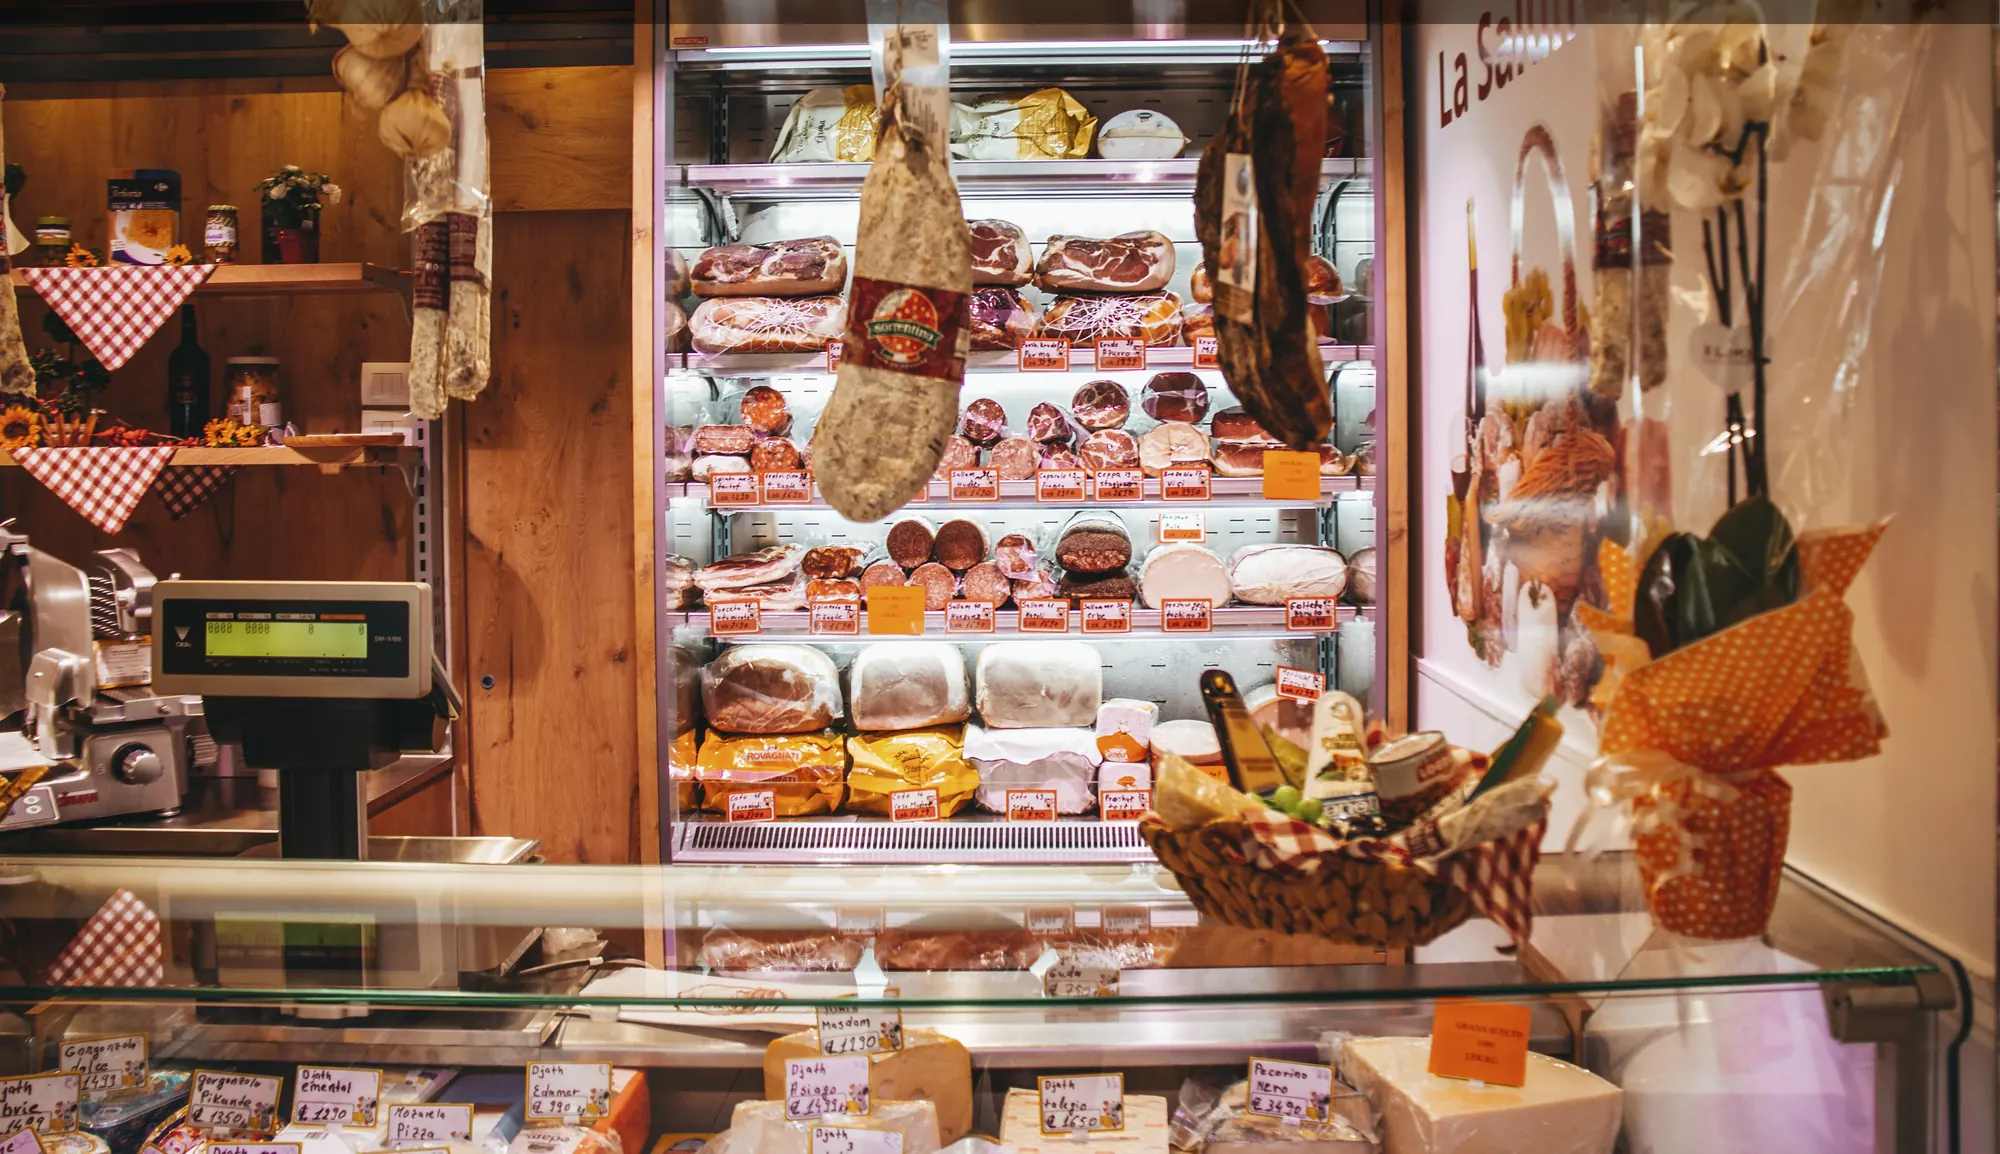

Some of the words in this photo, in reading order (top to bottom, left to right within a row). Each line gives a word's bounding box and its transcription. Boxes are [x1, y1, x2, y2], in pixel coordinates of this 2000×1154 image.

[1438, 50, 1469, 129] La
[747, 752, 800, 760] ROVAGNATI
[532, 1065, 564, 1079] Djath
[791, 1063, 826, 1080] Djath
[1254, 1062, 1308, 1080] Pecorino
[790, 1081, 837, 1102] Asiago
[1045, 1080, 1075, 1094] Djath
[549, 1100, 571, 1114] 990
[815, 1128, 848, 1144] Djath
